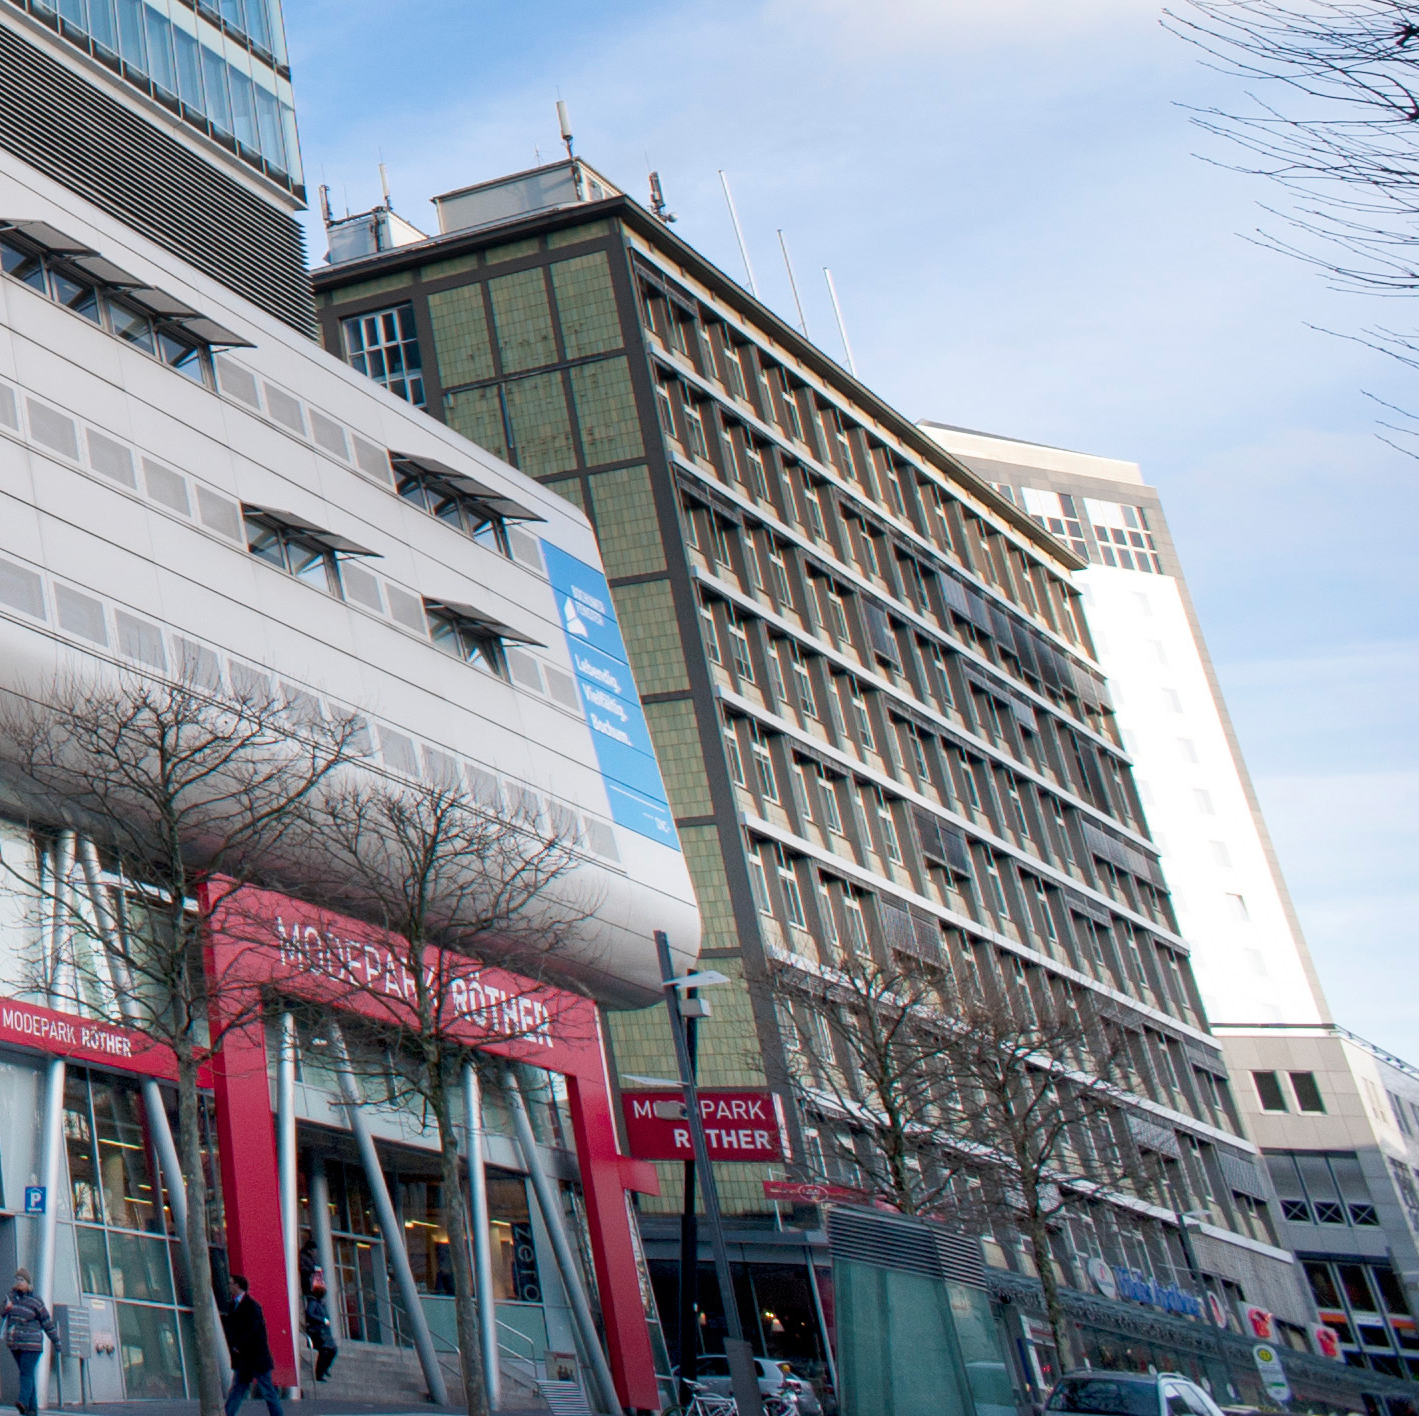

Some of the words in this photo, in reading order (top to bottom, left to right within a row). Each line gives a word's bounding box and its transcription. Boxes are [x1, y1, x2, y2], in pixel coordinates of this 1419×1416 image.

[2, 1007, 77, 1046] MODEPARK
[81, 1025, 132, 1058] RÖTHER
[633, 1100, 766, 1120] MPARK
[673, 1128, 772, 1150] RTHER
[515, 1225, 540, 1301] zero
